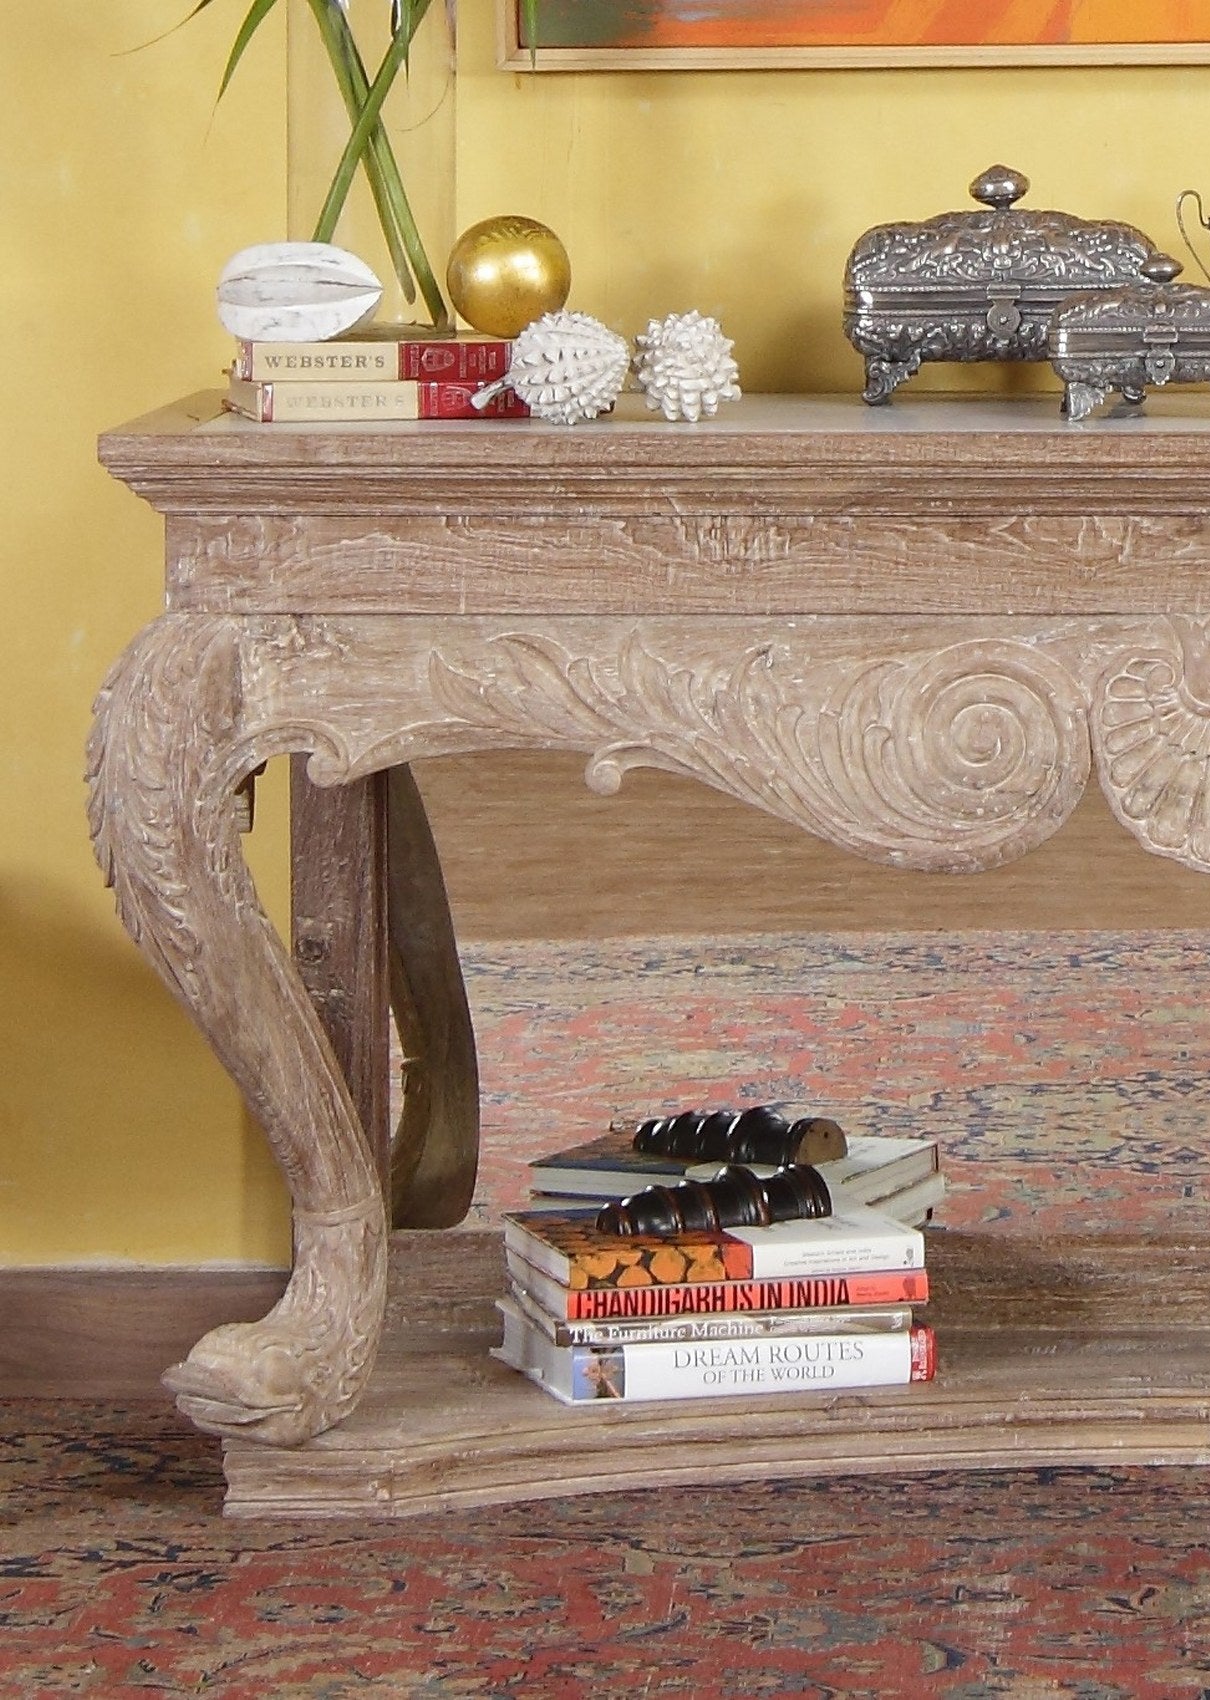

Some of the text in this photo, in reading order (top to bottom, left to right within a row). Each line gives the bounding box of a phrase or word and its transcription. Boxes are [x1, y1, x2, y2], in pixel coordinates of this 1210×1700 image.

[264, 355, 385, 369] WEBSTER'S
[284, 395, 405, 409] WEBSTERS
[576, 1278, 851, 1320] CHANDIGARH IS IN INDIA
[569, 1320, 764, 1344] The Furniture Machine
[673, 1341, 865, 1369] DREAM ROUTES
[703, 1365, 836, 1385] OF THE WORLD
